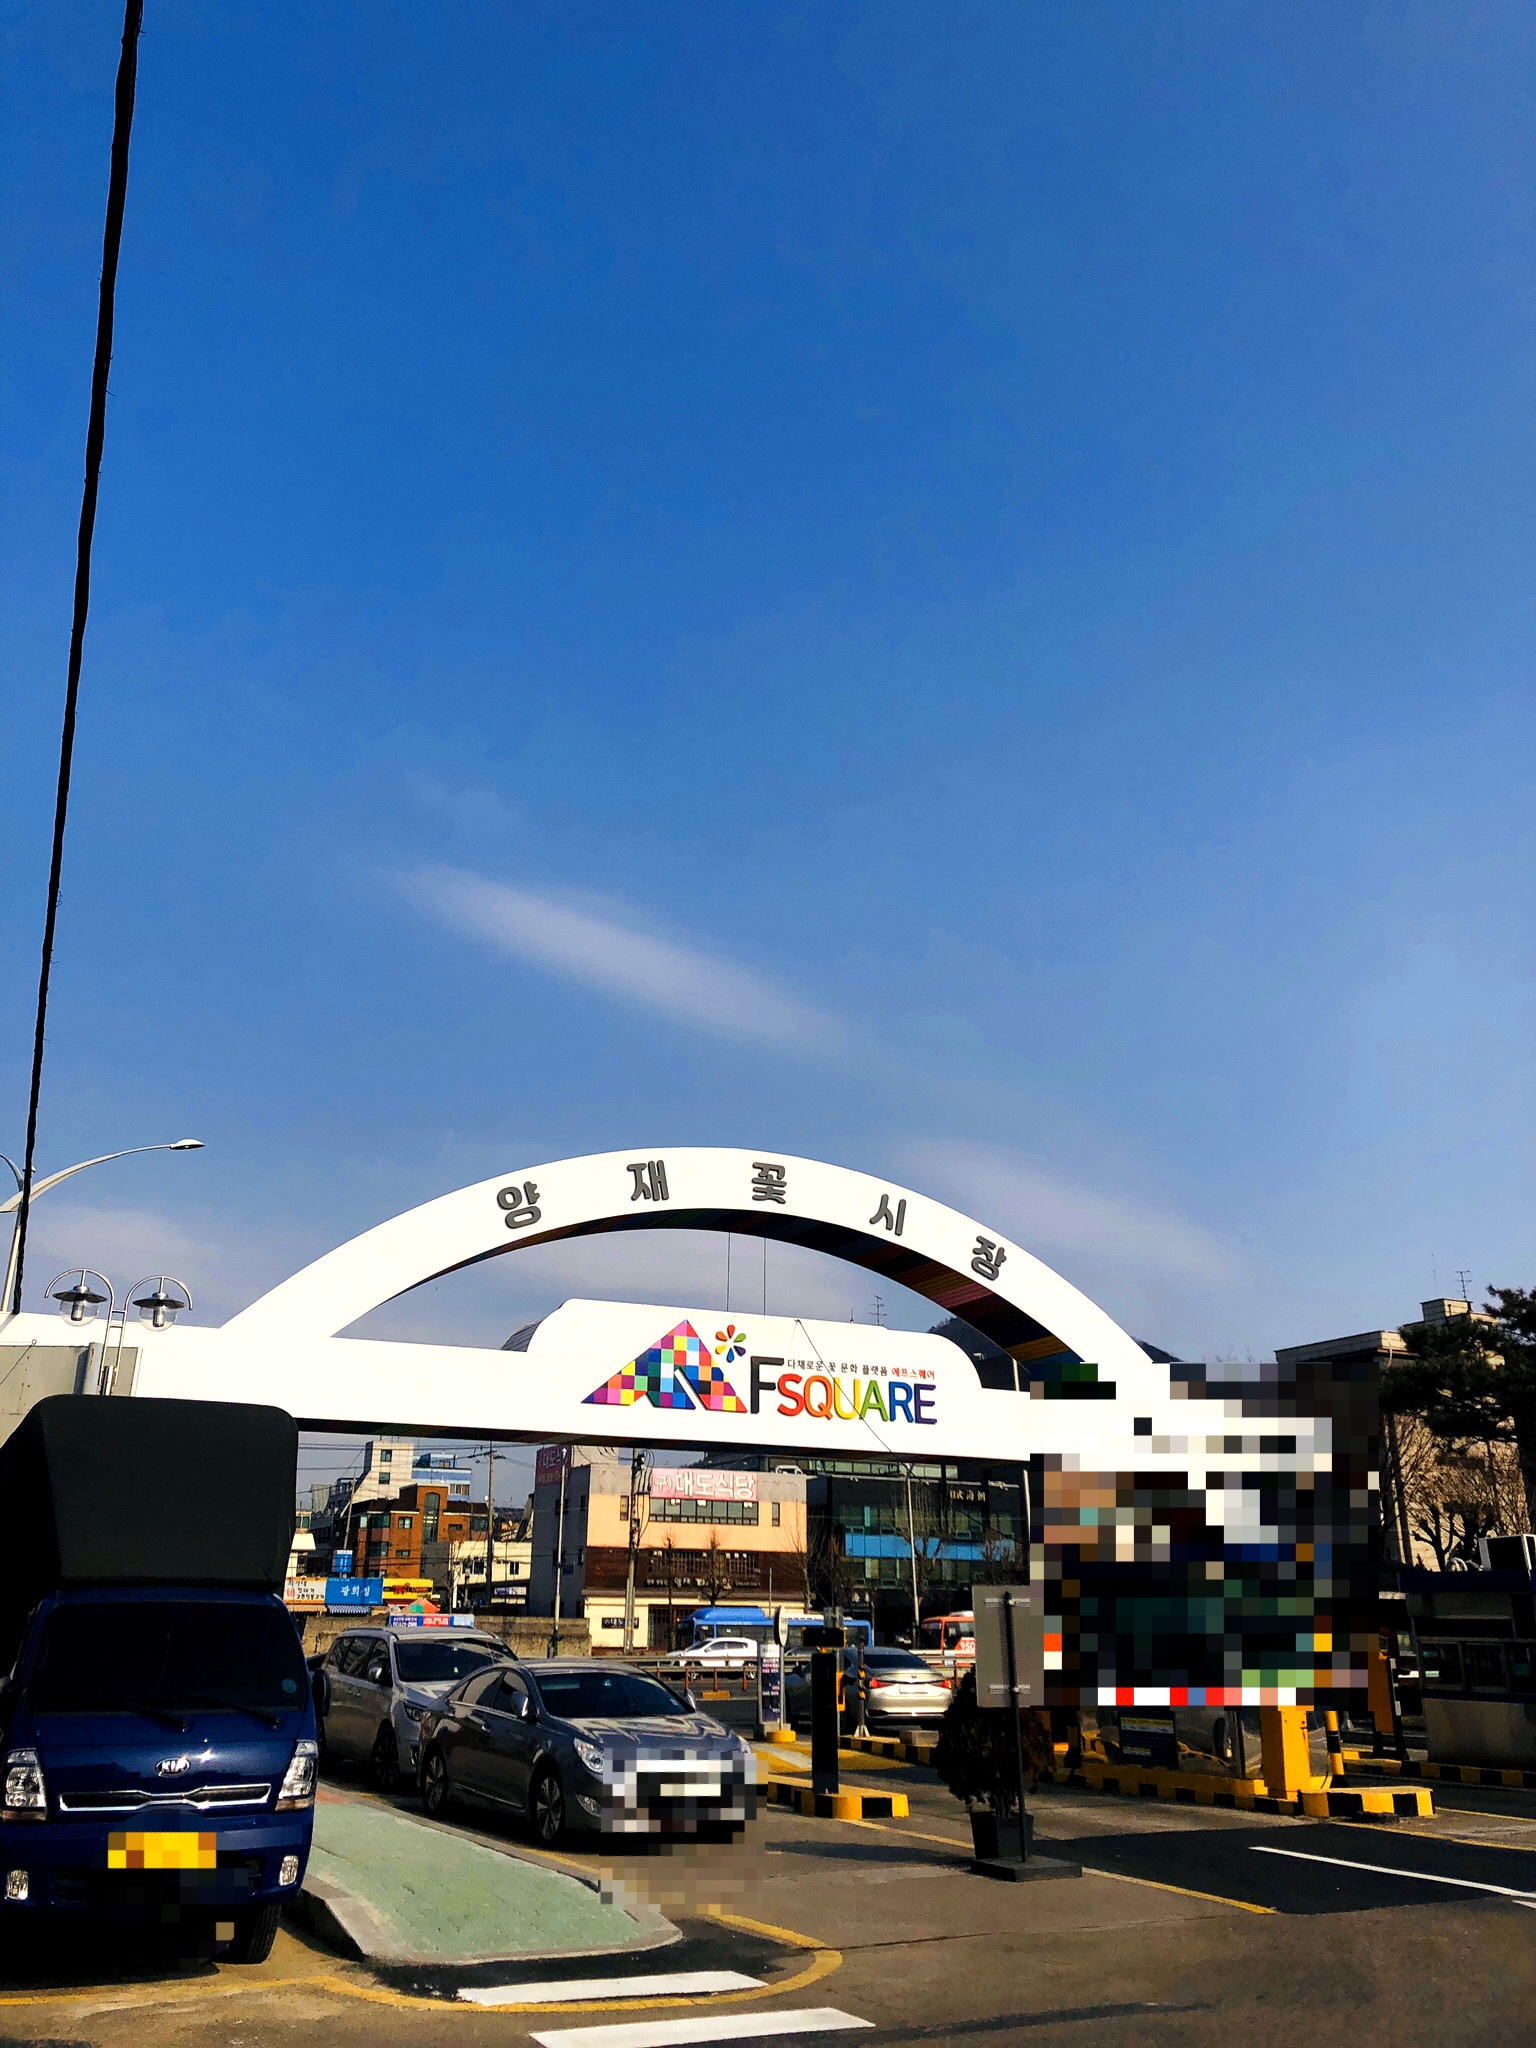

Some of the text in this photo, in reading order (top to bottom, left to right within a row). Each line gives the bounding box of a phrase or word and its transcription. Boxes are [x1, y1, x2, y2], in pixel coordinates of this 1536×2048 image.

[787, 1359, 824, 1371] 다채로운
[828, 1361, 836, 1372] 꽃
[840, 1363, 858, 1374] 문화
[862, 1364, 888, 1376] 플랫폼
[161, 1760, 186, 1773] KIA
